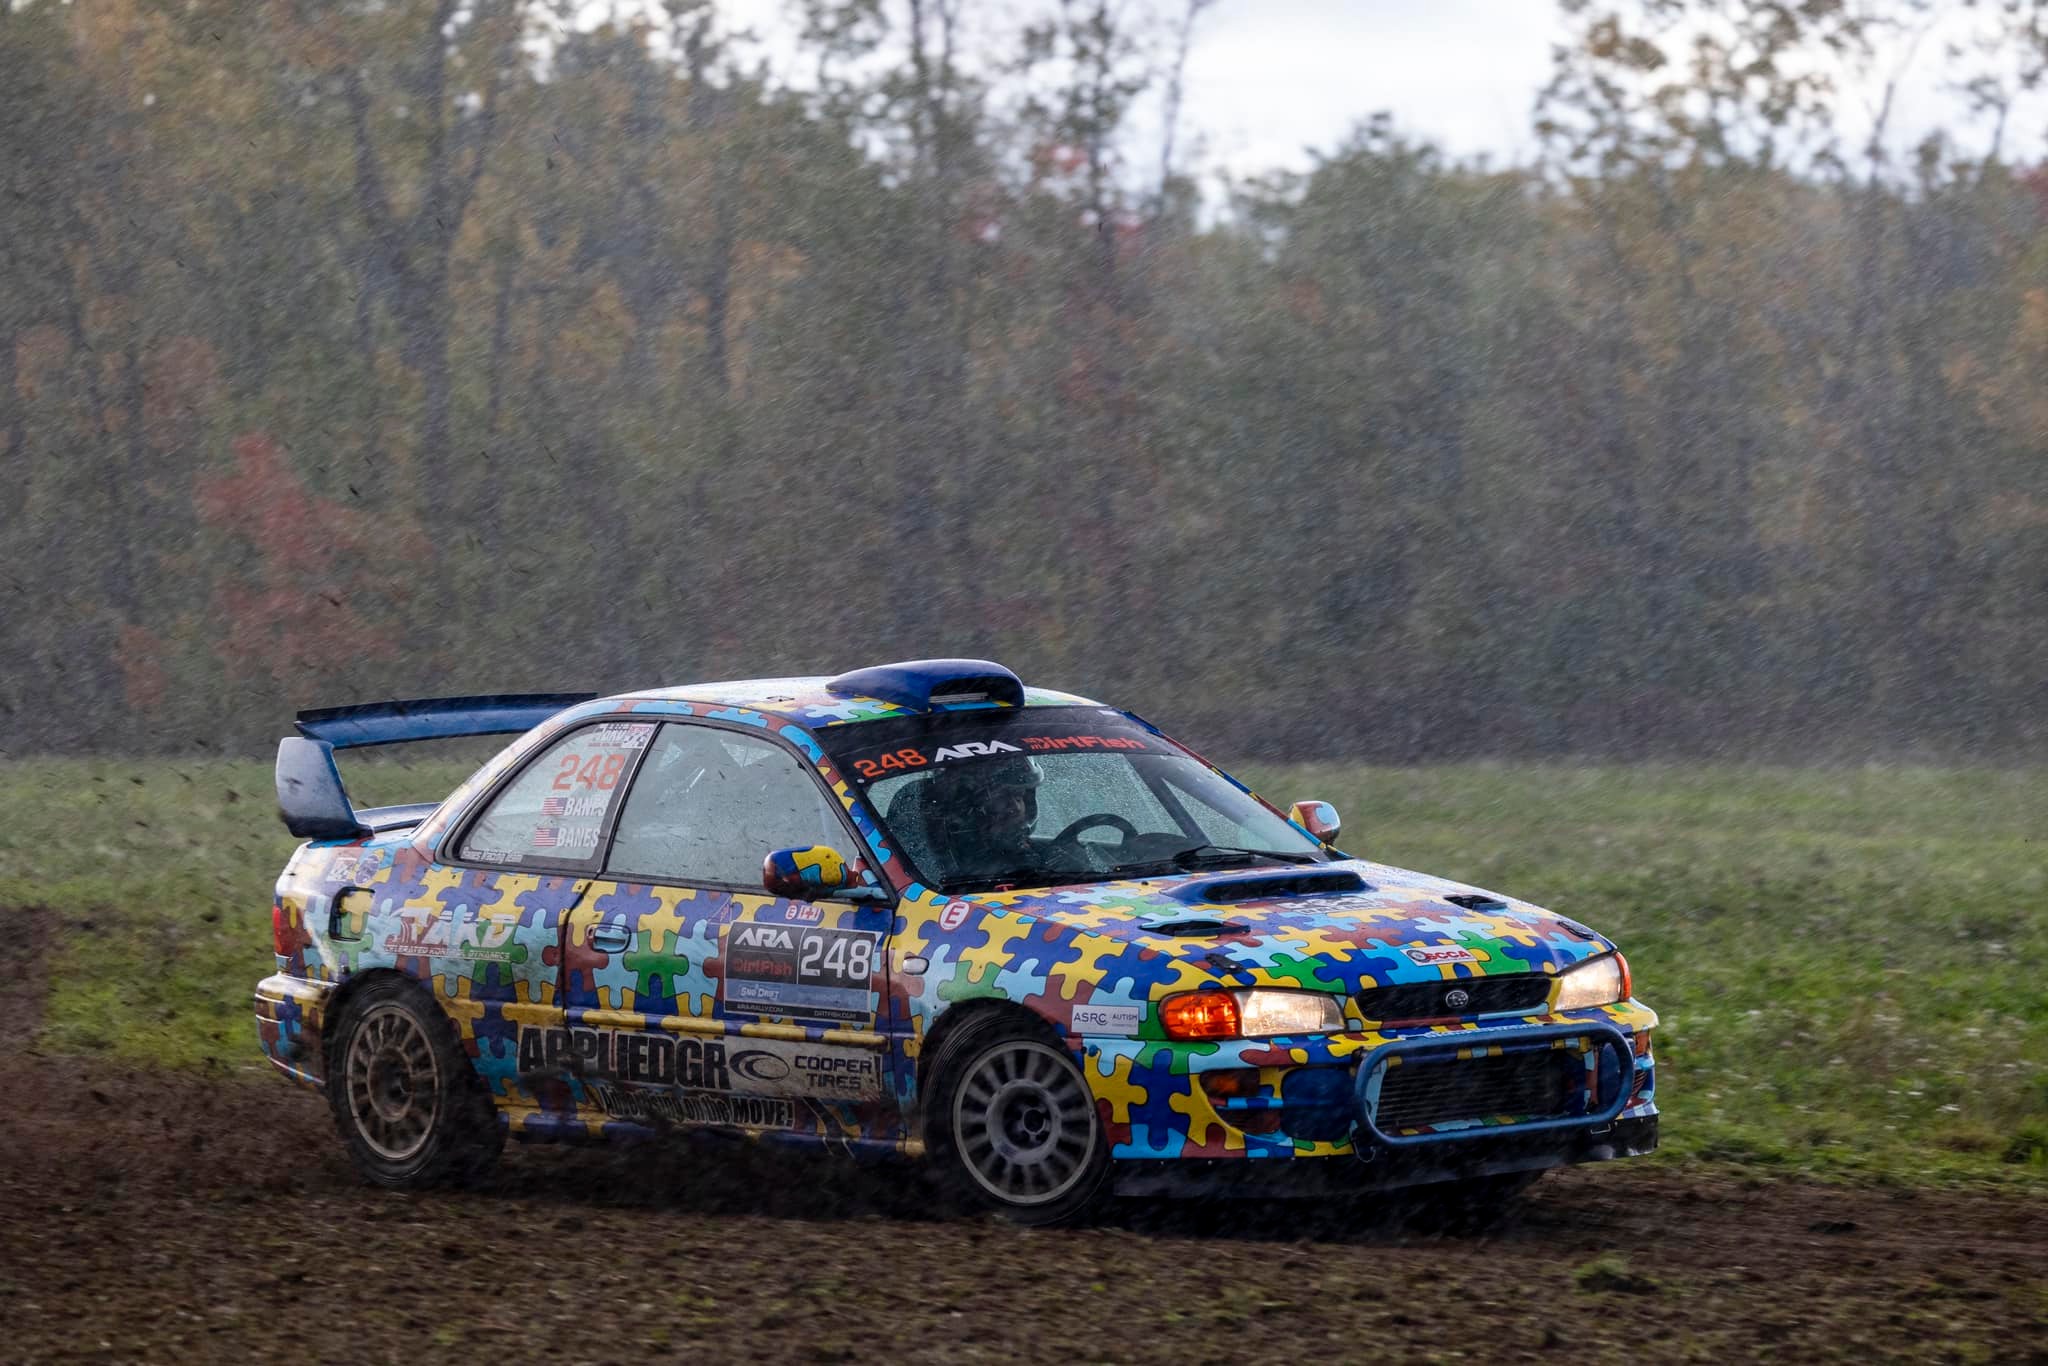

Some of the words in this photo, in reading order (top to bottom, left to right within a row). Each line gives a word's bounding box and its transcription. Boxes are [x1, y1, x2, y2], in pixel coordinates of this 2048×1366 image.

[854, 749, 927, 777] 248
[935, 740, 1023, 762] ARA
[552, 754, 625, 790] 248
[556, 828, 601, 847] BANES
[944, 905, 965, 924] E
[734, 928, 794, 949] ARA
[801, 935, 872, 980] 248
[1074, 1012, 1108, 1025] ASRC
[1112, 1013, 1138, 1021] AUTISM
[795, 1054, 872, 1073] COOPER
[807, 1073, 862, 1089] TIRES
[731, 1096, 795, 1130] MOVE!
